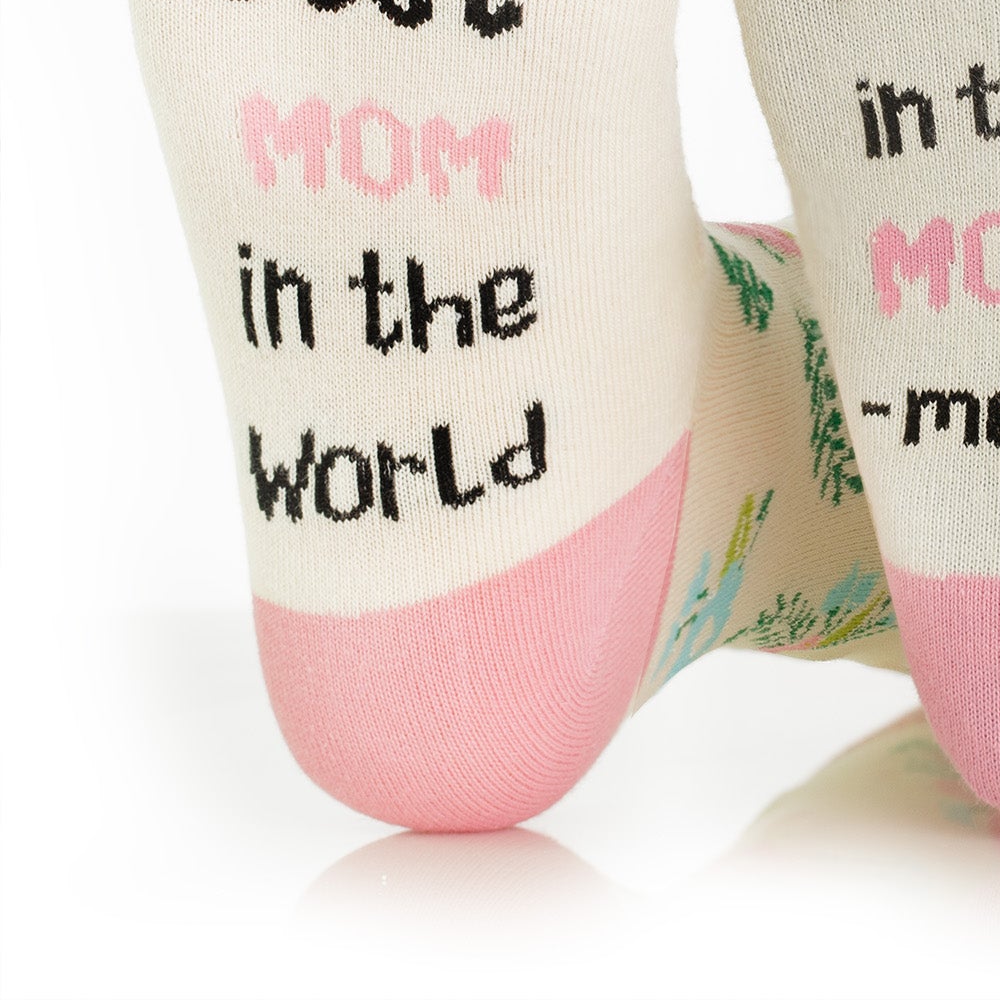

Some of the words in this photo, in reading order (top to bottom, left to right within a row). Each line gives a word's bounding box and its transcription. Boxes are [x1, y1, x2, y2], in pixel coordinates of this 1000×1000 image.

[240, 90, 513, 202] MOM
[855, 78, 938, 160] in
[237, 242, 315, 351] in
[348, 248, 537, 356] the
